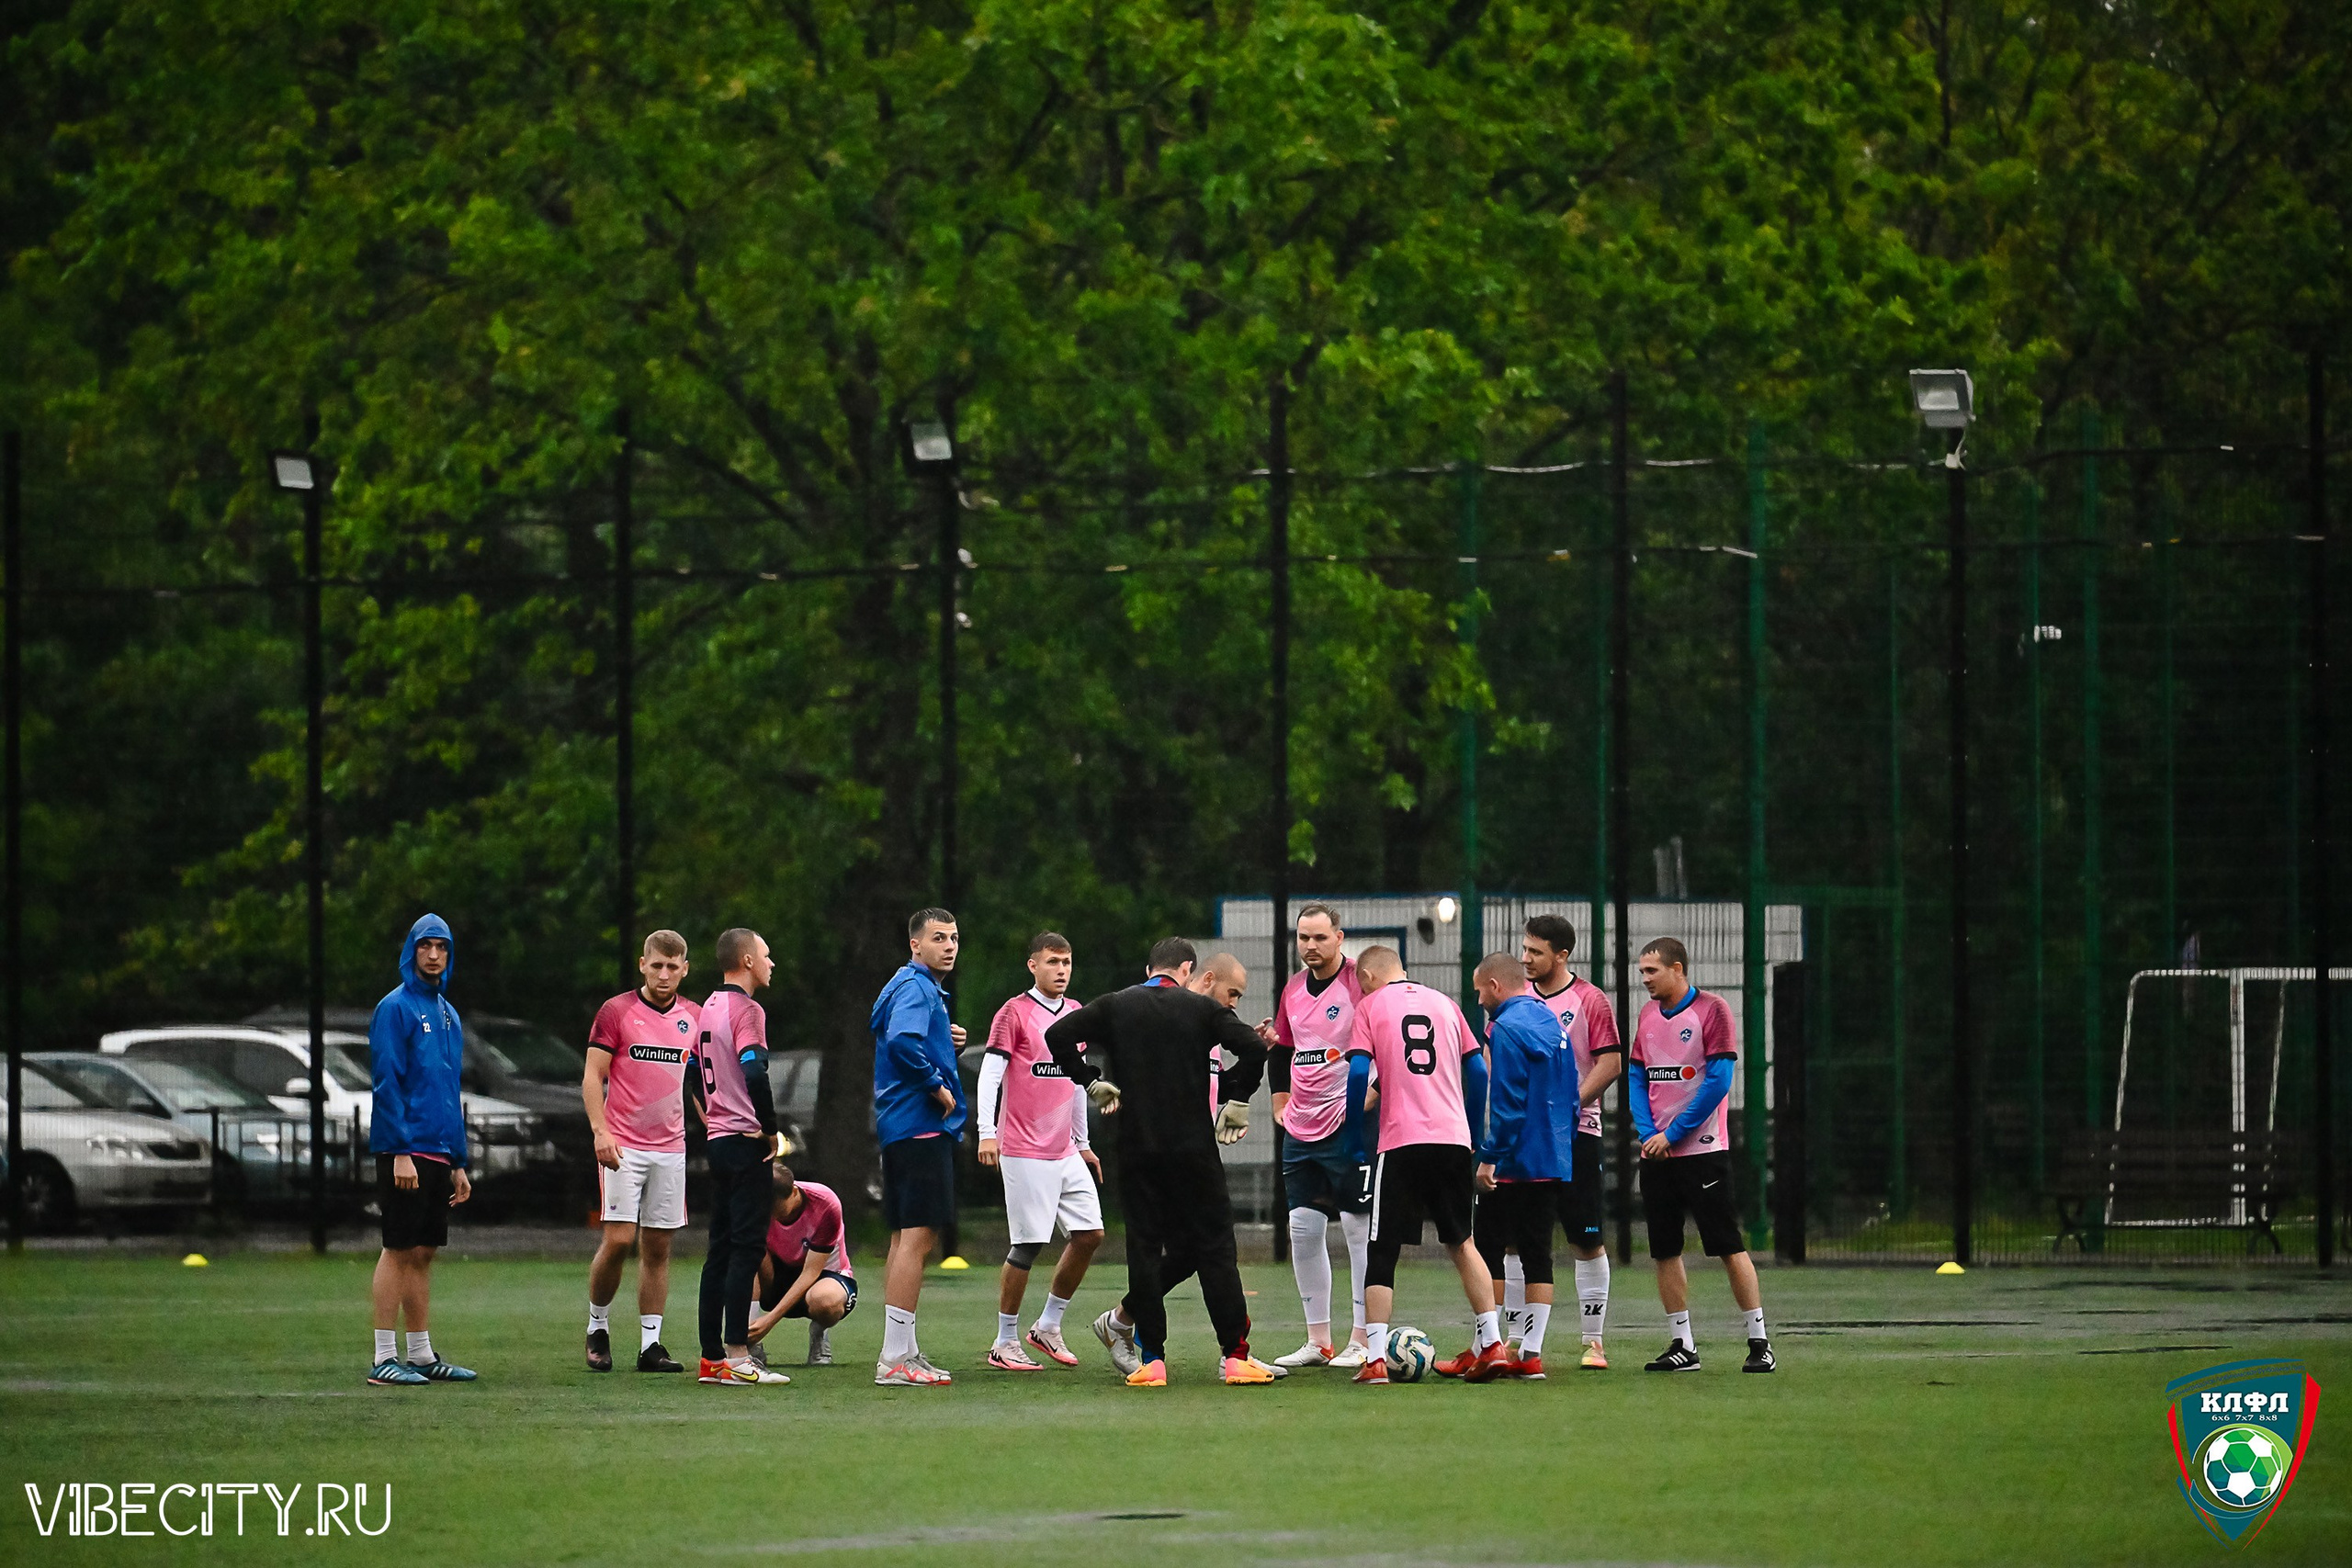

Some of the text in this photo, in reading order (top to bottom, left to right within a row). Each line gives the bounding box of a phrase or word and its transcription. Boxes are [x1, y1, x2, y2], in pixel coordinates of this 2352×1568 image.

[1401, 1014, 1437, 1076] 8
[633, 1047, 679, 1062] Winline
[1295, 1053, 1323, 1064] inline
[1036, 1065, 1064, 1076] Winli
[1359, 1165, 1371, 1191] 7
[1584, 1303, 1604, 1316] 2K
